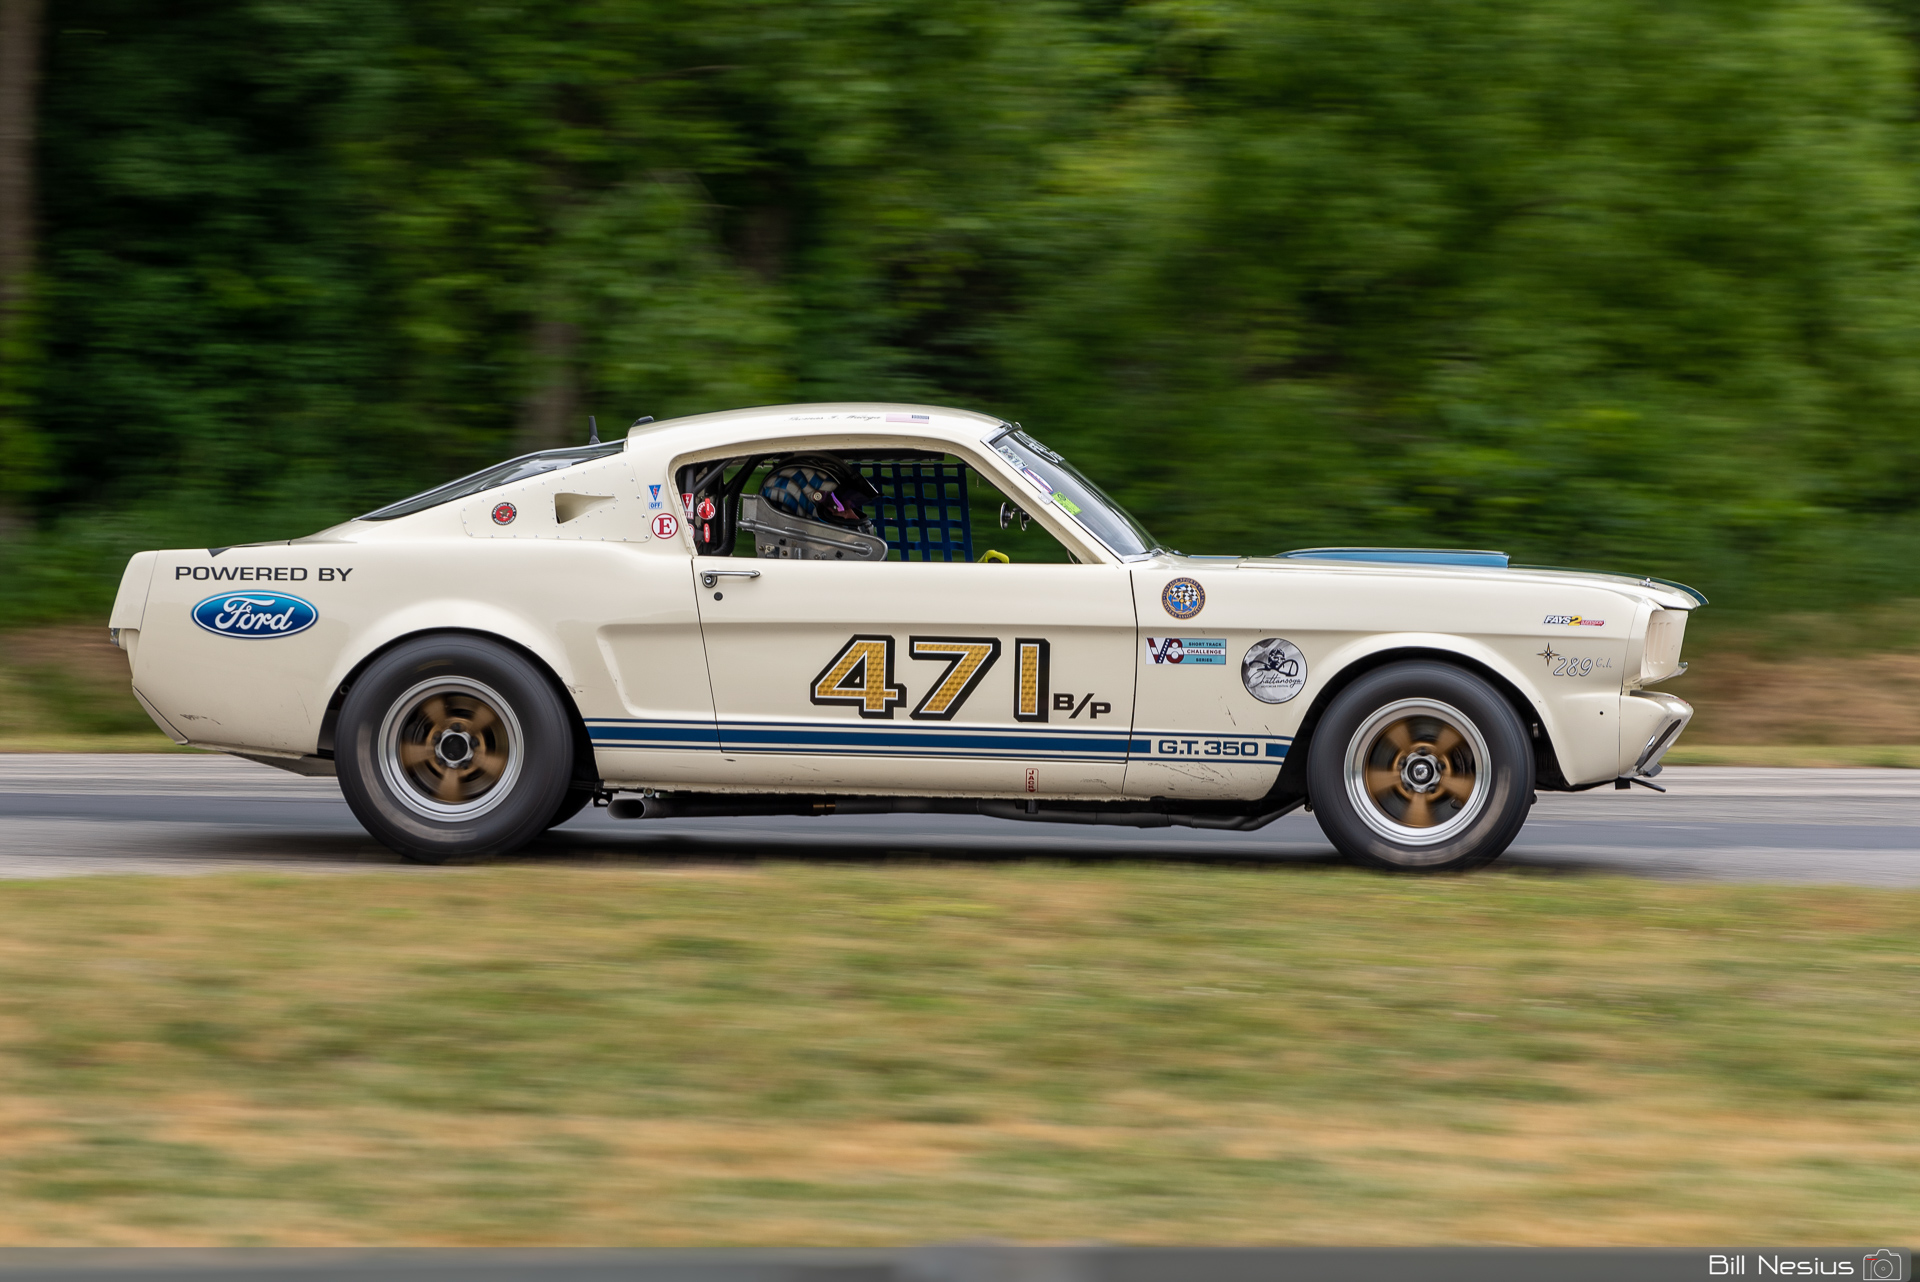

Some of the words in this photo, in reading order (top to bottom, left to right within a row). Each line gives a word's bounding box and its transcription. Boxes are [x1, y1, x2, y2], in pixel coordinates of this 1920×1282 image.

[658, 517, 672, 535] E
[175, 566, 308, 581] POWERED
[318, 567, 354, 582] BY
[214, 597, 295, 631] Ford
[1146, 637, 1185, 664] V8
[1553, 656, 1594, 677] 289
[810, 634, 1050, 723] 471
[1247, 671, 1303, 688] Chattanooga
[1053, 693, 1112, 720] B/P
[1027, 769, 1035, 790] JACK
